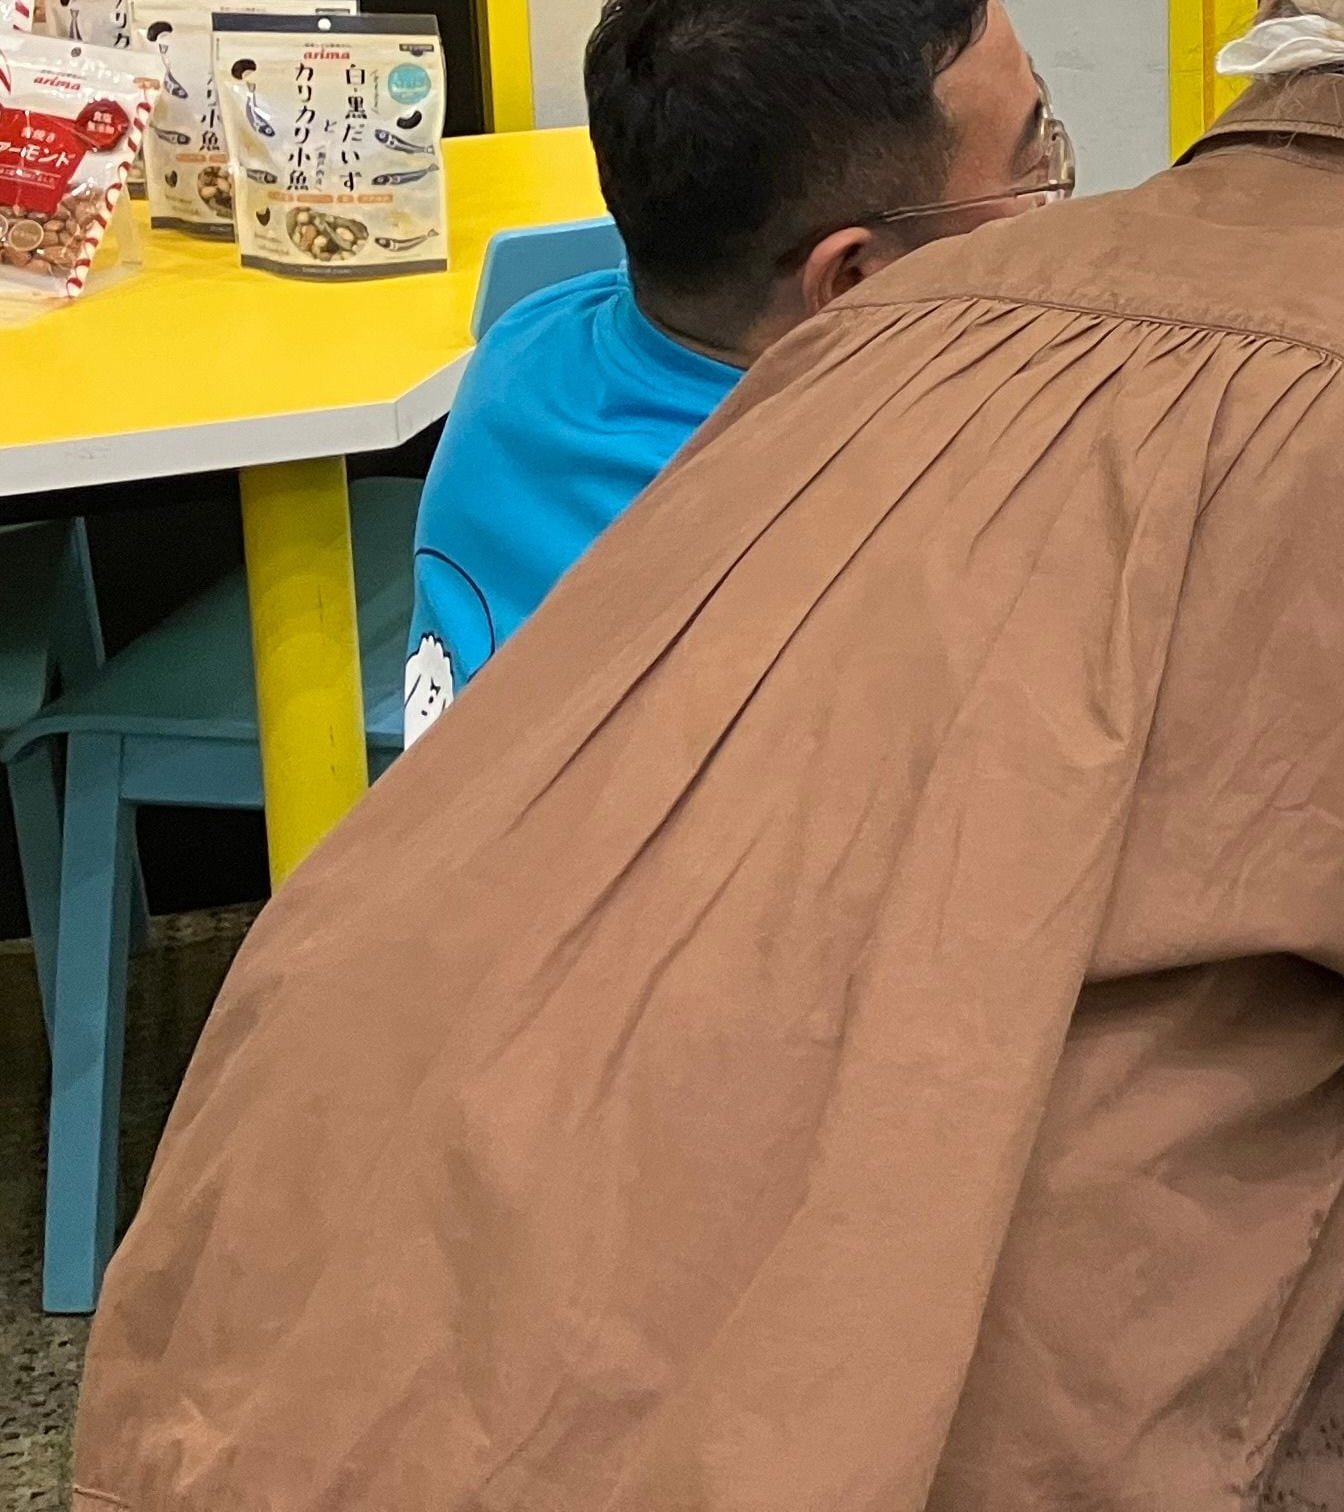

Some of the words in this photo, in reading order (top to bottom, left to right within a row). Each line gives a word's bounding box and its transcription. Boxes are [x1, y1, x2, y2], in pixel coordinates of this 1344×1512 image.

[303, 48, 351, 60] arima
[33, 76, 81, 91] arima
[287, 63, 316, 191] カリカリ小魚
